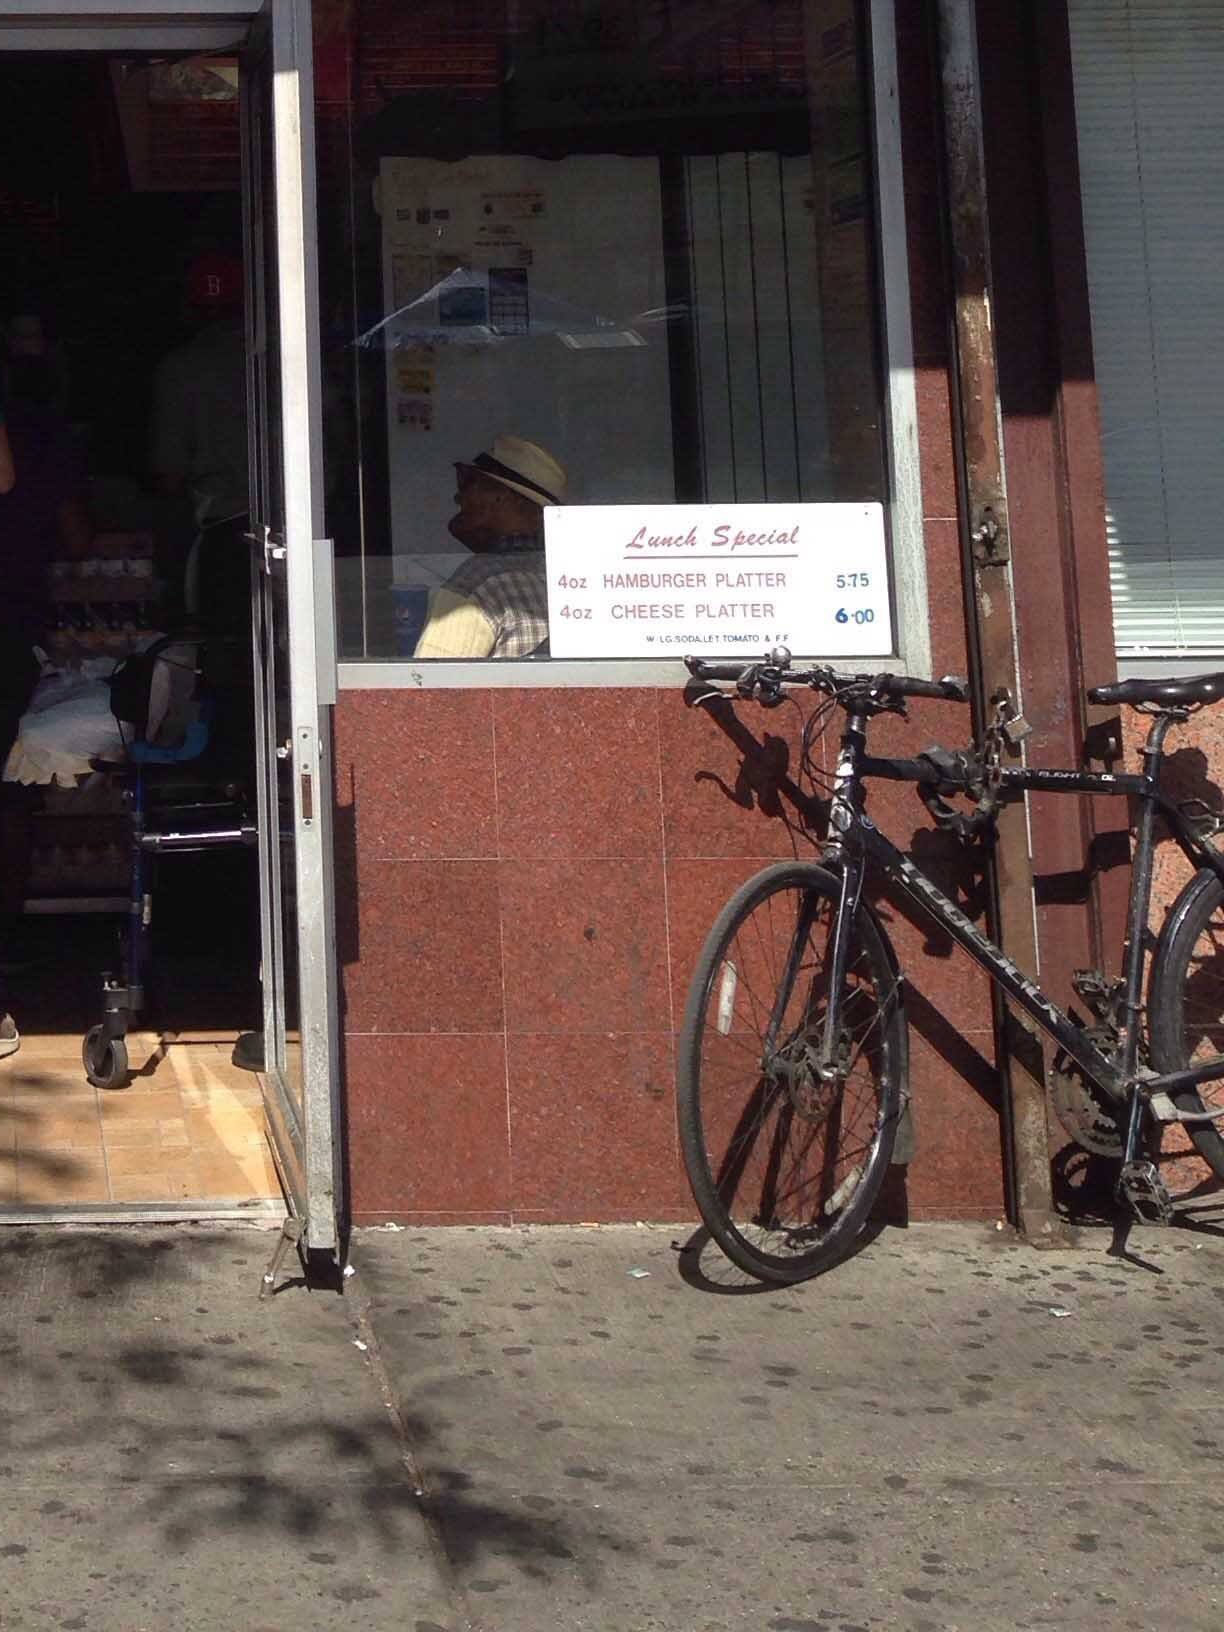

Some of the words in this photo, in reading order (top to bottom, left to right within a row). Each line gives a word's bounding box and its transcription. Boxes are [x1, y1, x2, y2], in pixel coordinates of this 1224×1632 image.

[625, 526, 697, 549] Lunch
[711, 525, 800, 551] Special
[557, 576, 587, 589] 4oz
[603, 574, 707, 588] HAMBURGER
[715, 573, 787, 587] PLATTER
[559, 606, 592, 620] 4oz
[611, 604, 685, 619] CHEESE
[696, 603, 775, 618] PLATTER
